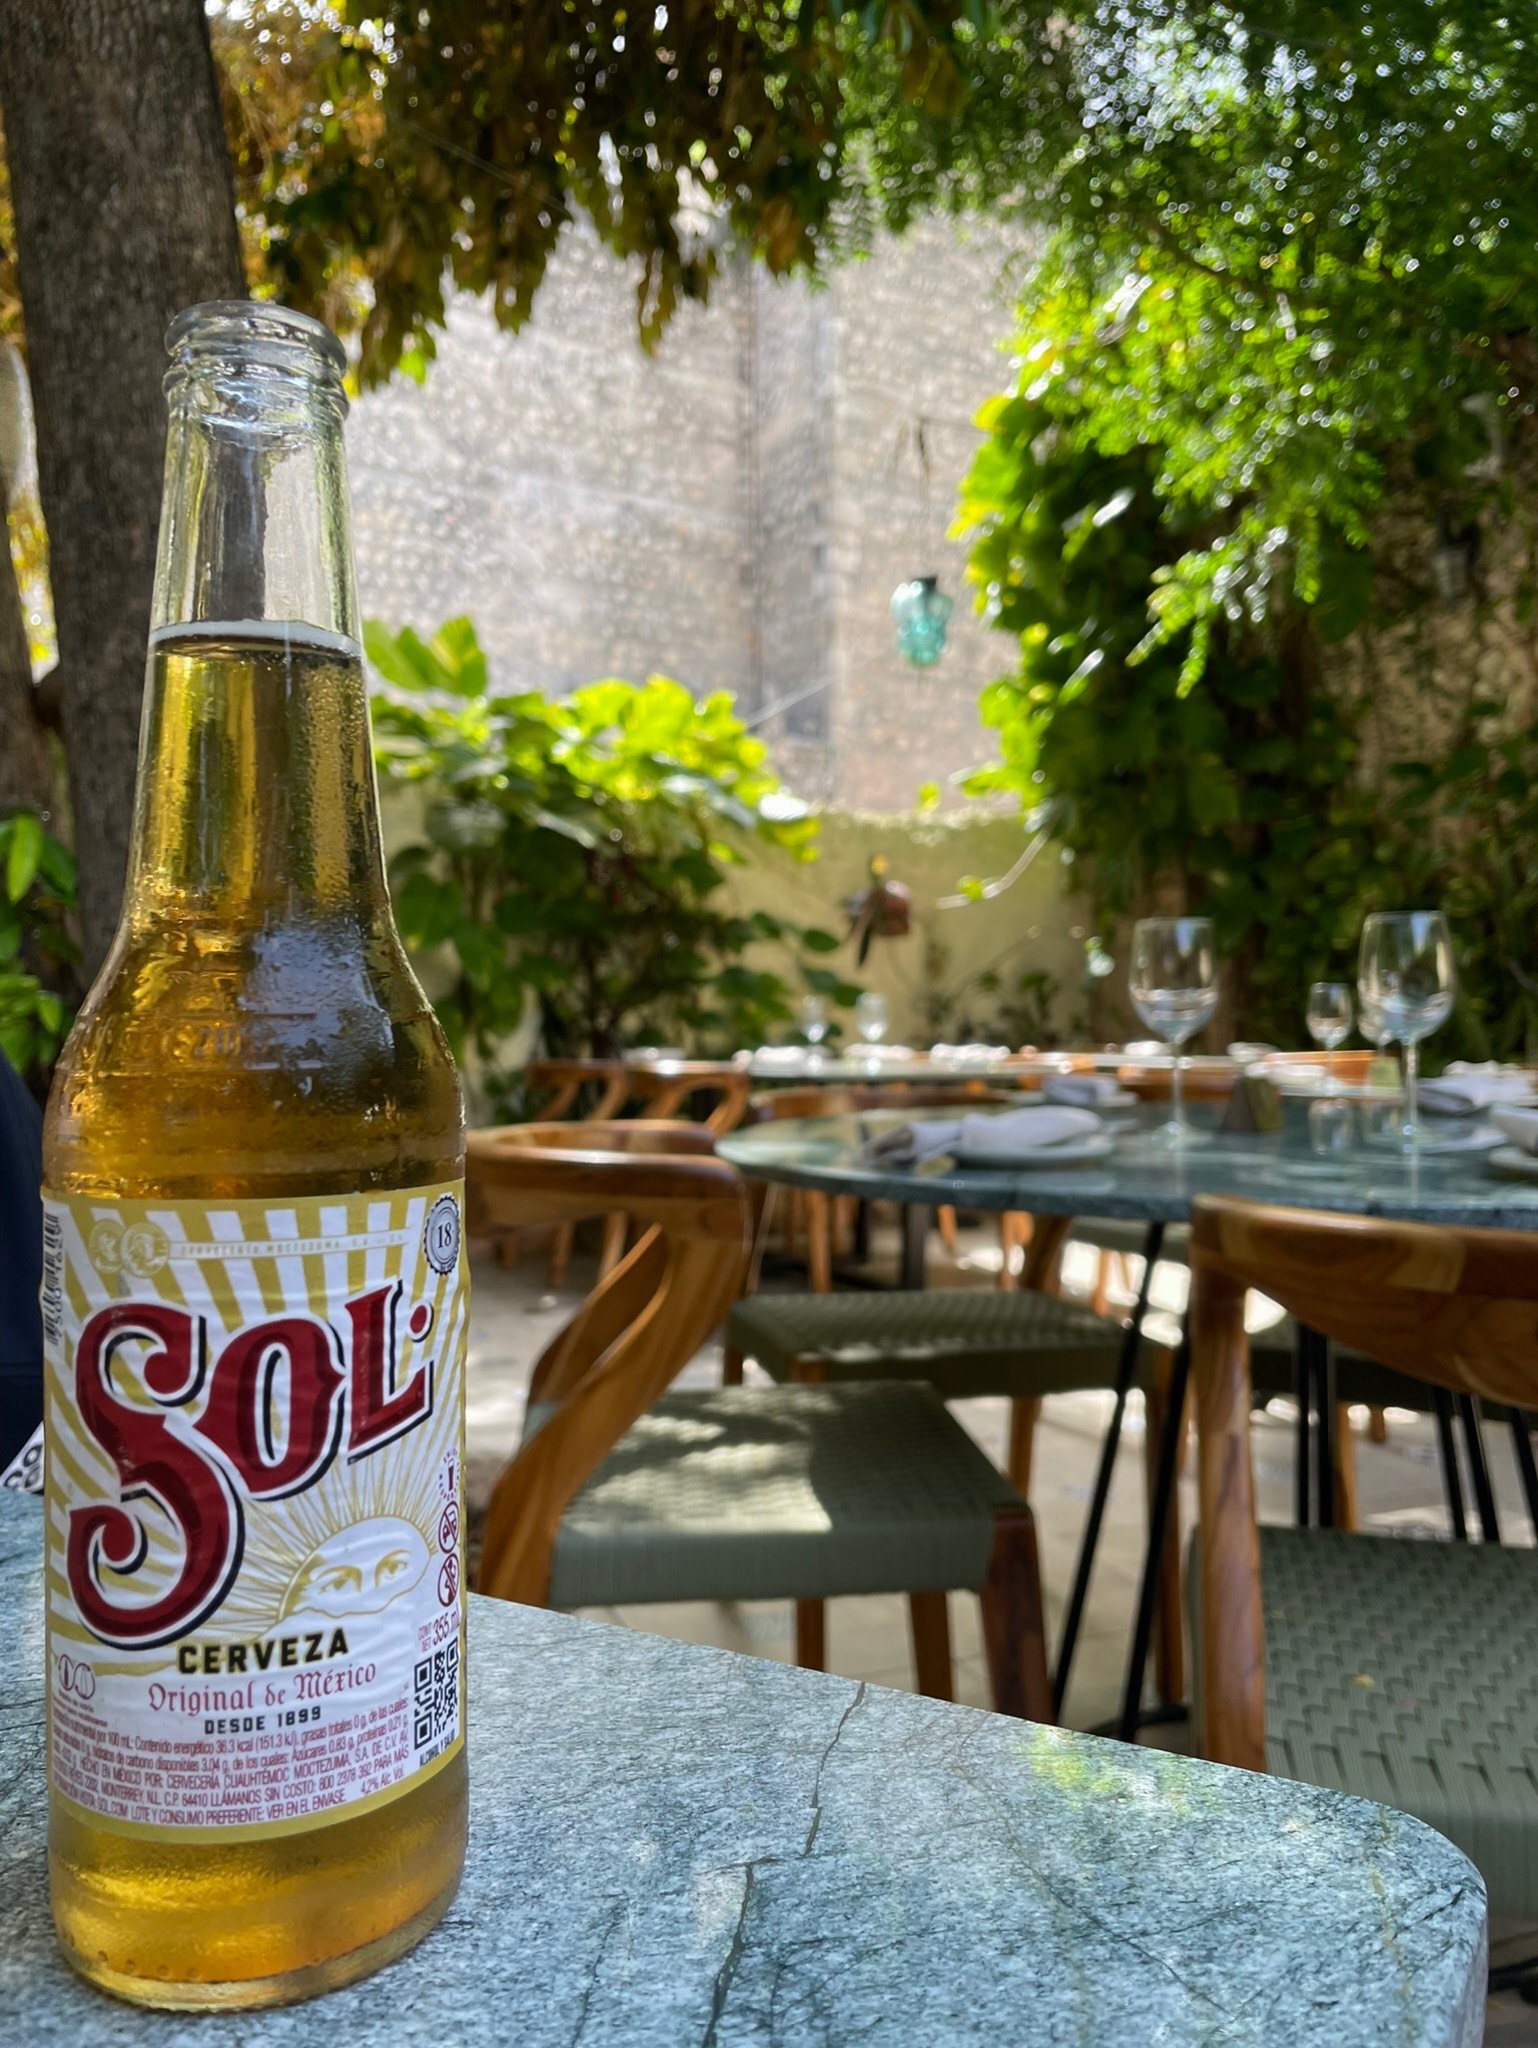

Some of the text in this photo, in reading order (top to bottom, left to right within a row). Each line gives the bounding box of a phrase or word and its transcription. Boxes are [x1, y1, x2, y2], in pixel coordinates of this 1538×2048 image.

[437, 1221, 452, 1249] 18
[432, 1612, 450, 1646] 355
[178, 1627, 350, 1674] CERVEZA
[148, 1682, 254, 1717] Original
[265, 1682, 286, 1707] de
[293, 1662, 377, 1700] México
[204, 1705, 322, 1735] DESDE 1899
[135, 1735, 172, 1754] Contenido
[237, 1737, 253, 1753] kcal
[223, 1767, 289, 1790] CUAUHTÉMOC
[372, 1739, 383, 1757] DE
[233, 1757, 244, 1770] de
[264, 1785, 280, 1803] SIN
[159, 1808, 205, 1826] CONSUMO
